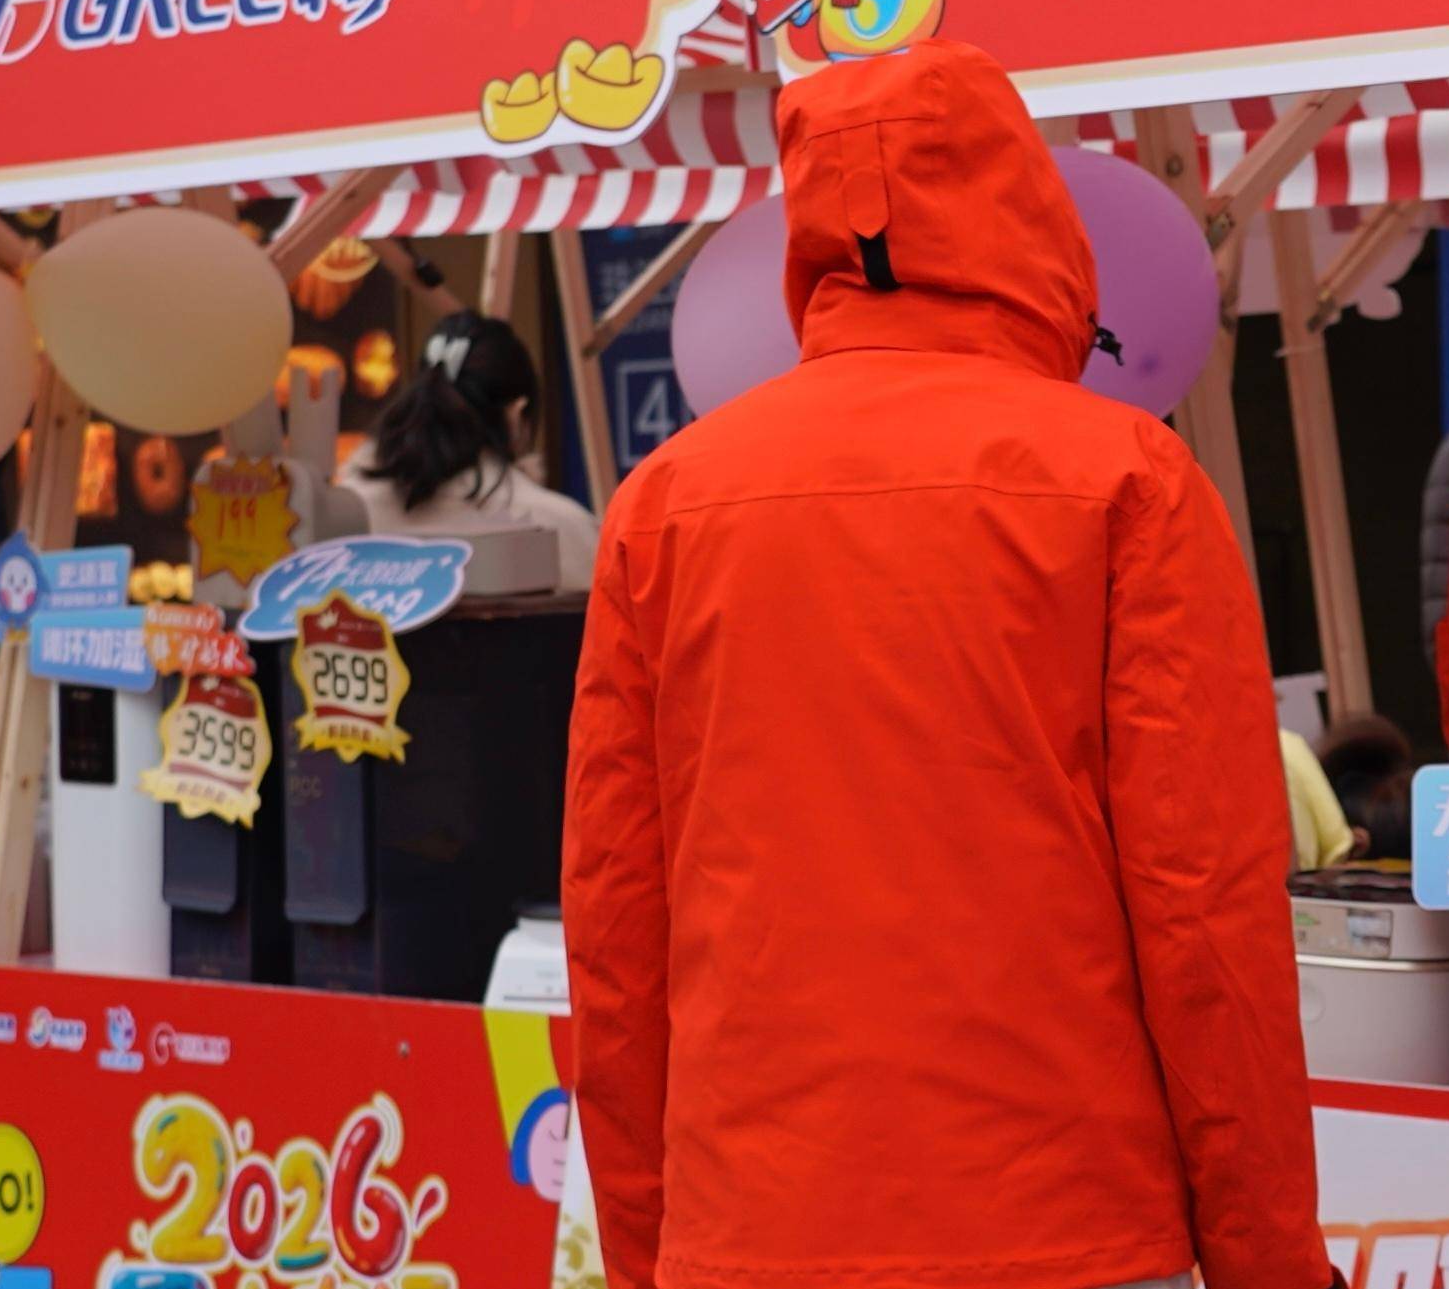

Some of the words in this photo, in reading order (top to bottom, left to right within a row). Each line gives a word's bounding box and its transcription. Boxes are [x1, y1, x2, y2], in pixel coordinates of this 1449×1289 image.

[313, 651, 390, 705] 2699
[176, 710, 257, 772] 3599
[137, 1102, 408, 1280] 2026
